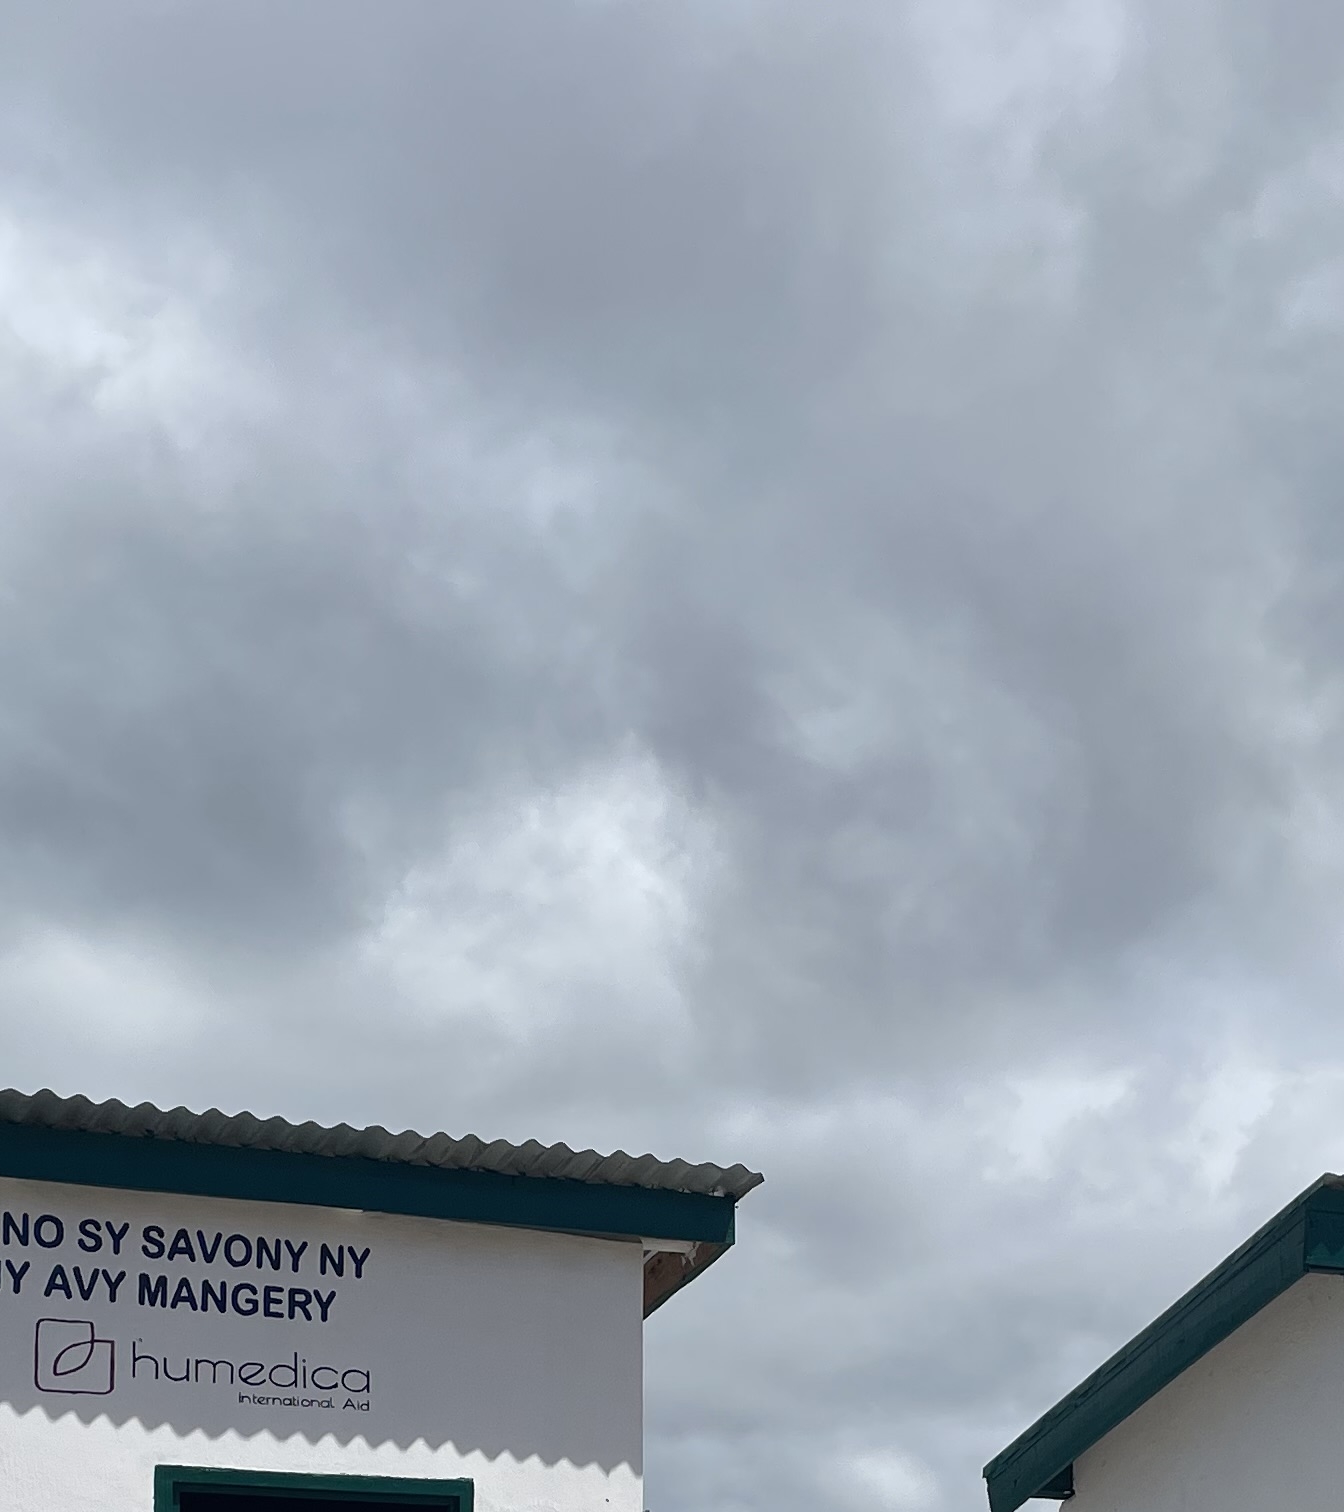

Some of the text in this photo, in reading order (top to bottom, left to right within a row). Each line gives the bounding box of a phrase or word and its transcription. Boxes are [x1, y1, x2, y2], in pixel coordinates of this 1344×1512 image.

[77, 1218, 130, 1256] SY
[141, 1225, 308, 1273] SAVONY
[319, 1242, 371, 1279] NY
[43, 1263, 127, 1303] AVY
[138, 1272, 337, 1322] MANGERY
[132, 1340, 371, 1393] humedica
[238, 1391, 370, 1411] International Aid
